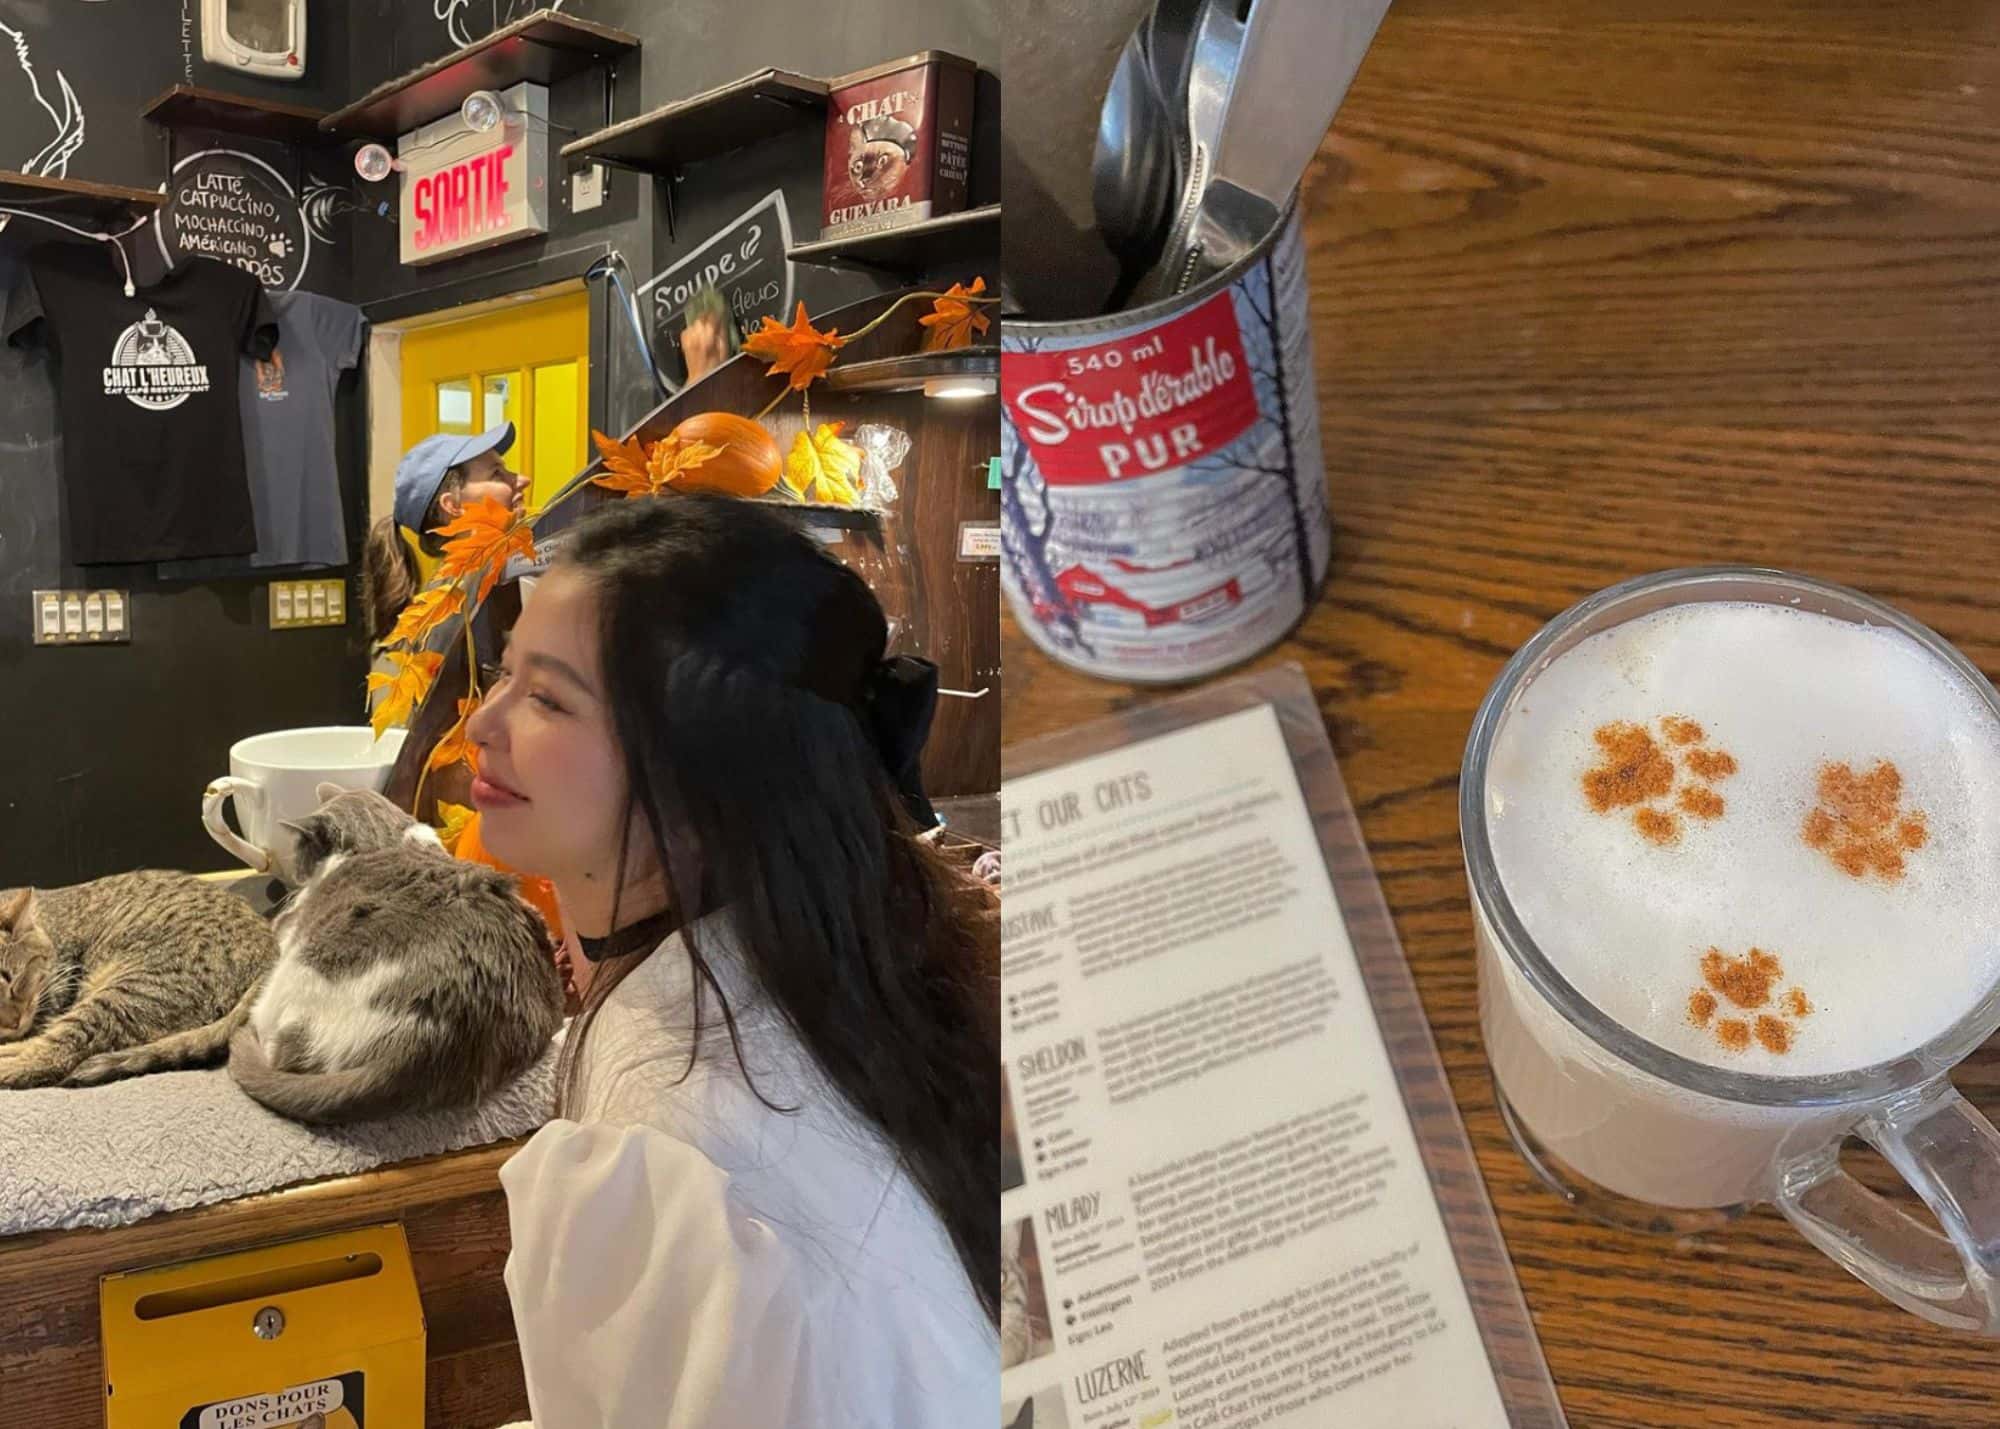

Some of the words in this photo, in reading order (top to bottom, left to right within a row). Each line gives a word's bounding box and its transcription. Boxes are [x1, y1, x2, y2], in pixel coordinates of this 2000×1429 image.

[847, 91, 909, 125] CHAT
[414, 144, 514, 250] SORTIE
[830, 195, 912, 224] GUEVARA
[655, 253, 736, 319] Soupe
[1066, 350, 1122, 375] 540
[1132, 336, 1163, 361] ml
[103, 367, 137, 387] CHAT
[139, 365, 210, 386] L'HEUREUX
[104, 387, 123, 395] CAT
[150, 384, 210, 394] RESTAURANT
[1017, 382, 1138, 445] Sirop
[1099, 423, 1203, 479] PUR
[1038, 792, 1082, 830] OUR
[1094, 770, 1152, 813] CATS
[1017, 1035, 1086, 1080] SHELDON
[1044, 1191, 1100, 1233] MILADY
[1211, 1316, 1239, 1332] from
[1075, 1349, 1151, 1404] LUZERNE
[216, 1397, 269, 1420] DONS
[276, 1384, 330, 1407] POUR
[219, 1415, 257, 1429] LES
[262, 1398, 326, 1421] CHATS
[1221, 1401, 1248, 1418] Chat
